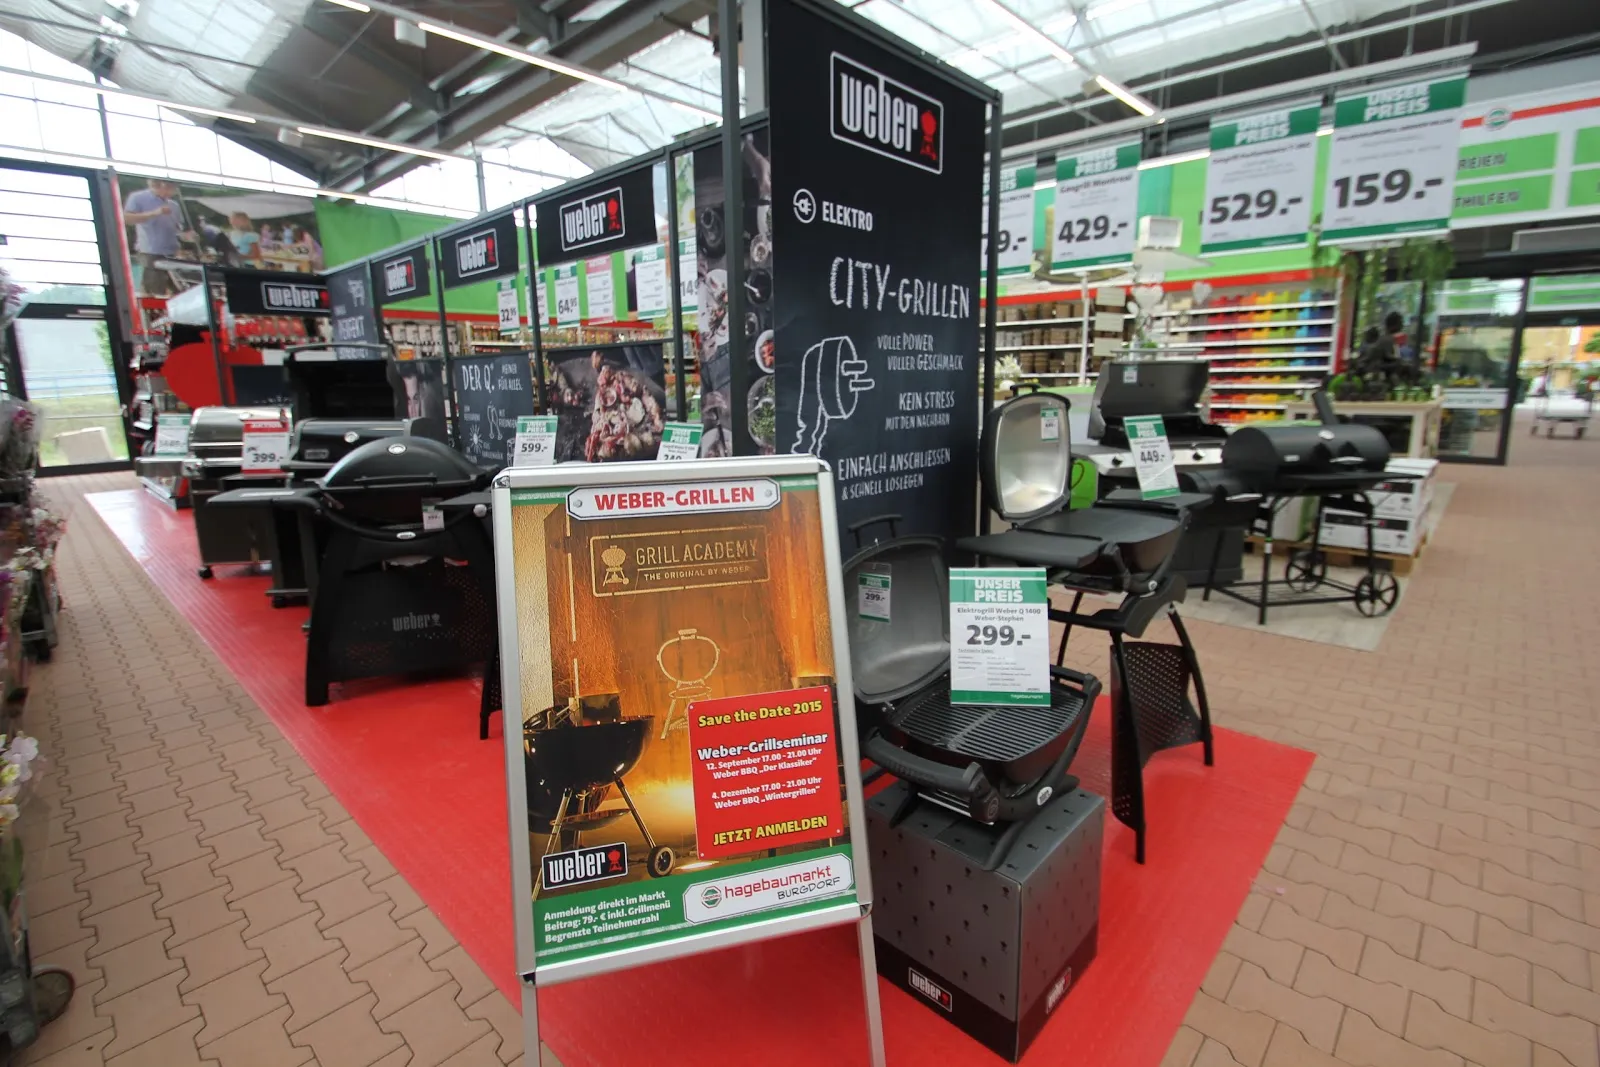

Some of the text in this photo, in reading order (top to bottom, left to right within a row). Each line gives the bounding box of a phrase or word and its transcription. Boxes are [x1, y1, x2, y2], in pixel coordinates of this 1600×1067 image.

[840, 72, 918, 152] weber
[1364, 98, 1430, 121] PREIS
[1235, 124, 1290, 145] PREIS
[1335, 169, 1443, 209] 159.-
[822, 200, 873, 232] ELEKTRO
[1210, 189, 1303, 225] 529.-
[565, 200, 606, 243] weber
[1058, 215, 1128, 243] 429.-
[459, 239, 487, 271] weber
[268, 286, 319, 308] weber
[829, 256, 970, 319] CITY-GRILLEN
[877, 332, 934, 351] VOLLE POWER
[887, 353, 964, 371] VOLLER GESCHMACK
[462, 364, 482, 391] DER
[899, 391, 955, 411] KEIN STRESS
[885, 413, 950, 431] MIT DEN NACHBARN
[521, 443, 548, 452] 599.-
[838, 448, 950, 481] EINFACH ANSCHLIESSEN
[594, 487, 755, 511] WEBER-GRILLEN
[842, 473, 923, 500] & SCHNELL LOSLEGEN
[636, 538, 758, 566] GRILL ACADEMY
[644, 566, 750, 581] THE ORIGINAL BY WEBER
[974, 579, 1021, 589] UNSER
[974, 590, 1023, 602] PREIS
[392, 612, 430, 631] weber
[966, 624, 1031, 646] 299.-
[698, 700, 822, 727] Save the Date 2015
[697, 733, 828, 760] Weber-Grillseminar
[706, 762, 717, 771] 12.
[718, 757, 760, 769] September
[762, 753, 782, 762] 17.00
[787, 750, 807, 759] 21.00
[808, 748, 822, 756] Uhr
[713, 768, 739, 779] Weber
[741, 766, 758, 777] BBQ
[712, 792, 719, 800] 4.
[721, 786, 760, 798] Dezember
[761, 782, 780, 792] 17.00
[787, 779, 807, 789] 21.00
[808, 776, 822, 784] Uhr
[715, 798, 741, 809] Weber
[742, 795, 760, 805] BBQ
[713, 815, 828, 846] JETZT ANMELDEN
[548, 851, 606, 883] weber
[725, 866, 831, 898] hagebaumarkt
[777, 876, 840, 900] BURGDORF
[544, 890, 665, 921] Anmeldung direkt im Markt
[545, 899, 671, 932] Beitrag: 79.- € inkl. Grillmenü
[545, 928, 591, 943] Begrenzte
[592, 913, 659, 933] Teilnehmerzahl
[912, 972, 941, 1000] weber
